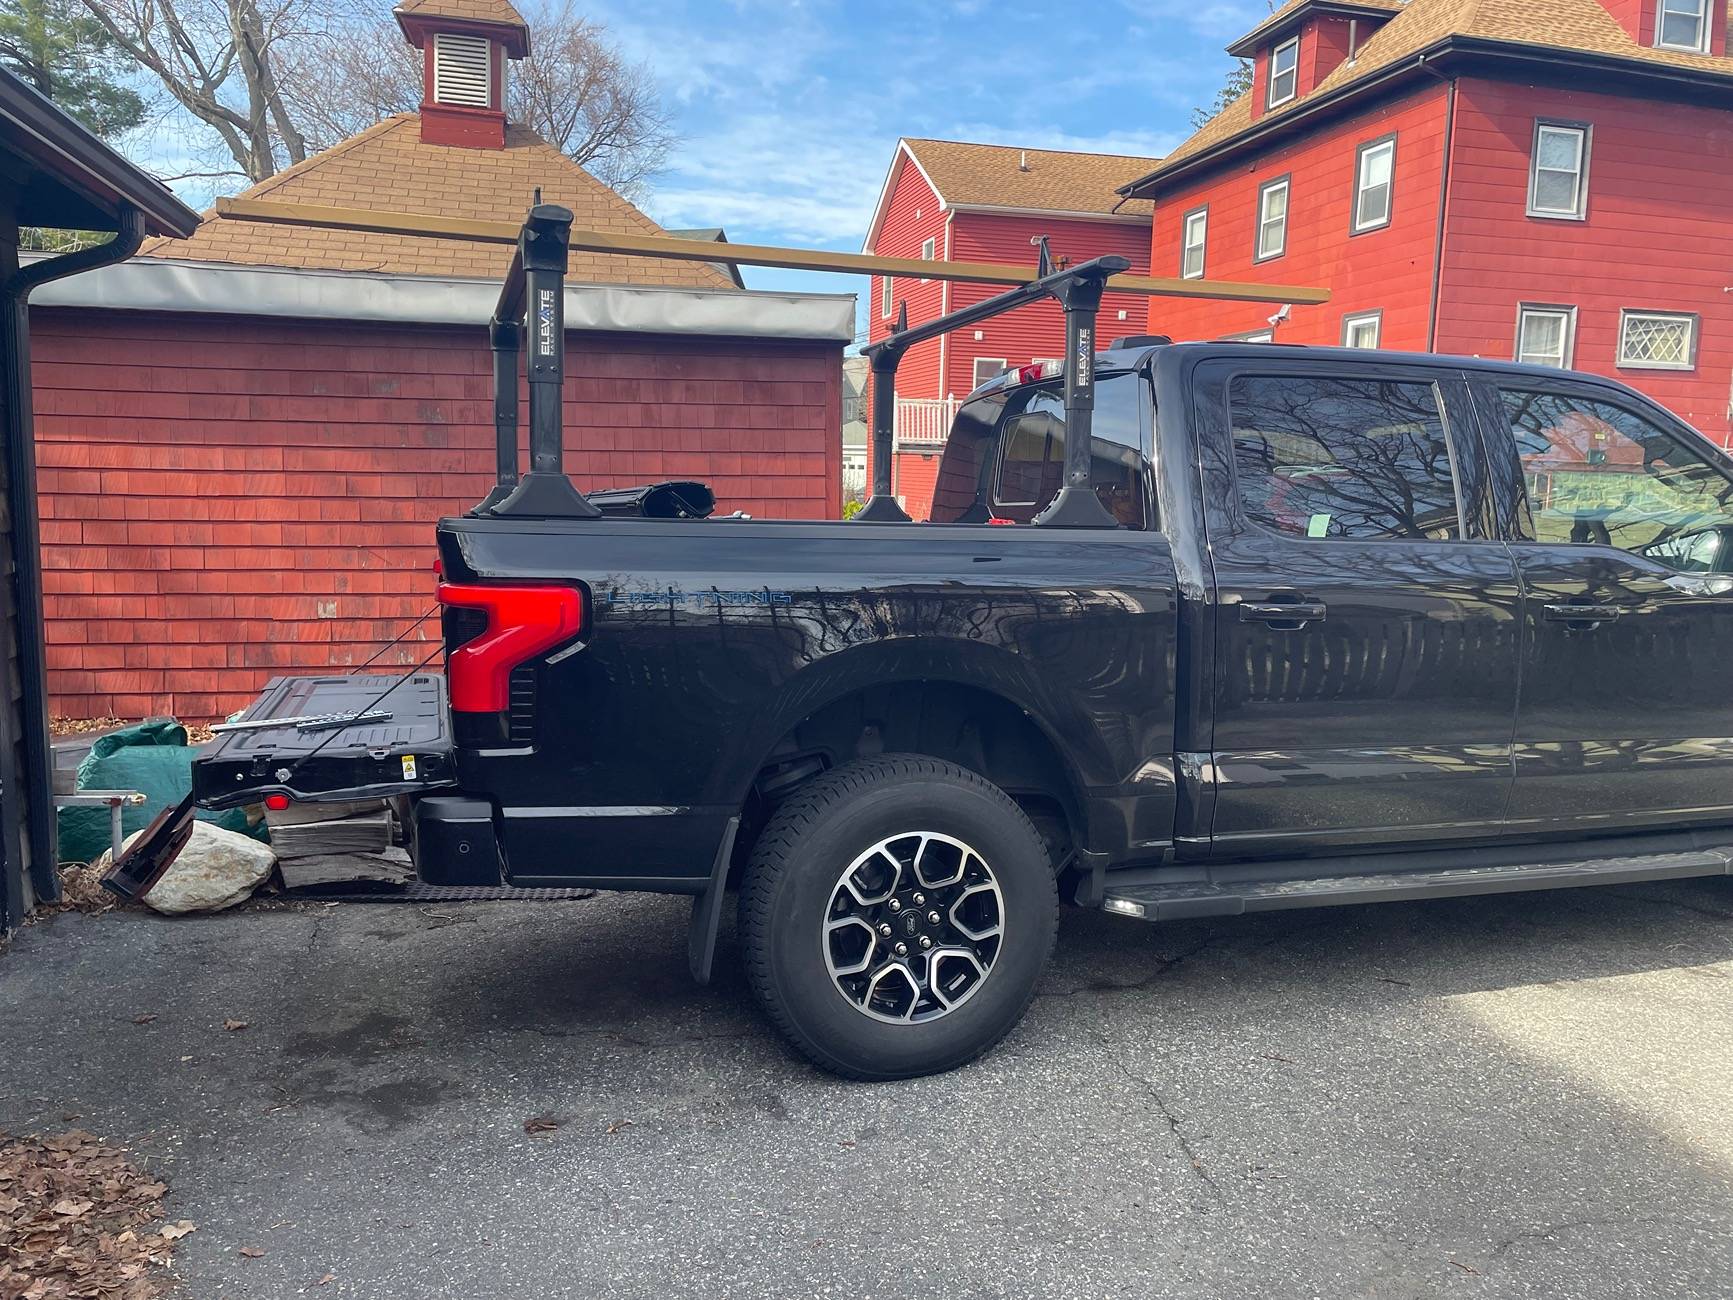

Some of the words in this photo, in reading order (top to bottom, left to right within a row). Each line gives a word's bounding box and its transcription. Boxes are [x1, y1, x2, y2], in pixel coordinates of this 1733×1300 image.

[540, 290, 550, 356] ELEVATE
[1078, 328, 1087, 386] ELEVATE
[608, 591, 792, 607] LIGHTNING
